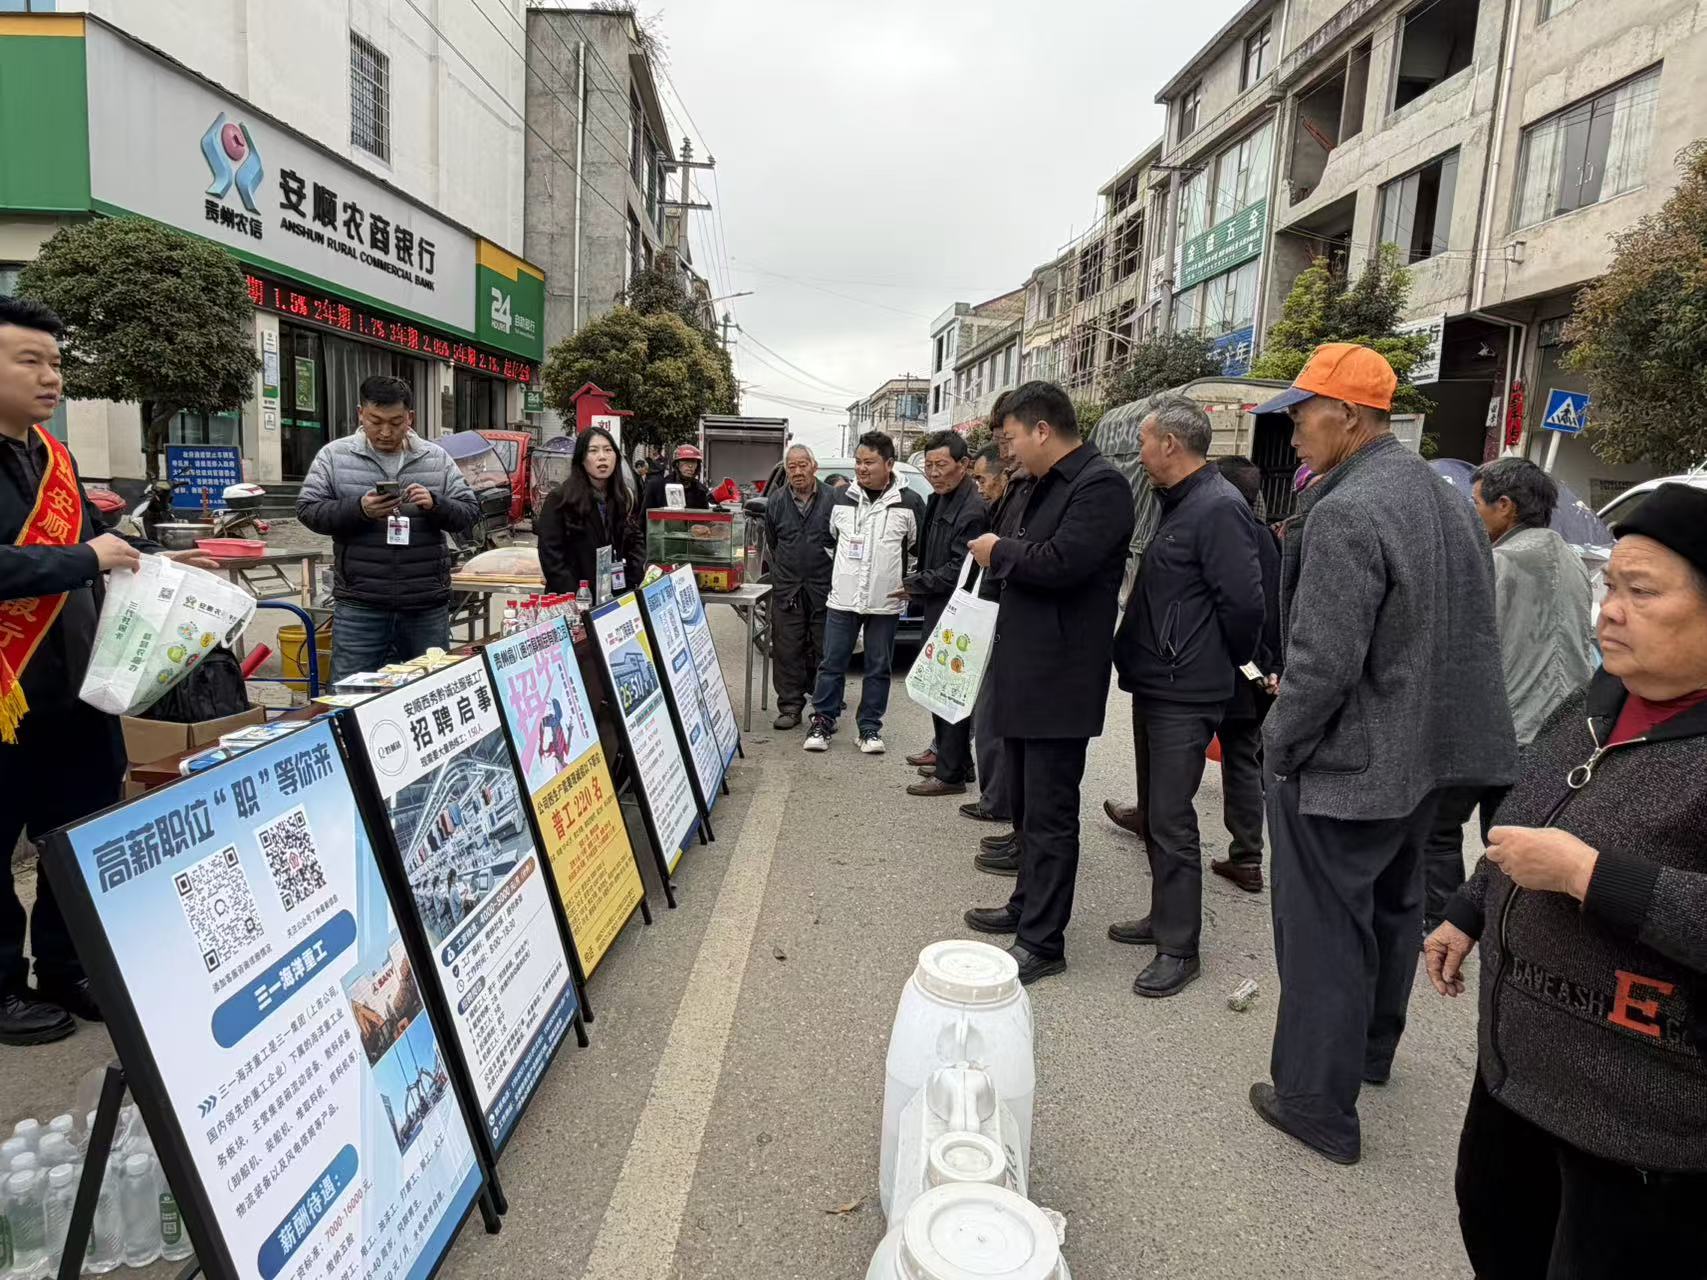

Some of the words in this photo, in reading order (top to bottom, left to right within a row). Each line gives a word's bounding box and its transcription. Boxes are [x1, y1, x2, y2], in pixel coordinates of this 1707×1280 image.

[205, 199, 263, 240] 贵州农信
[280, 168, 435, 275] 安顺农商银行
[280, 218, 325, 246] ANSHUN
[327, 237, 358, 260] RURAL
[360, 252, 413, 283] COMMERCIAL
[415, 275, 435, 292] BANK
[274, 288, 308, 316] 1.5%
[314, 299, 352, 330] 2年期
[358, 314, 387, 338] 1.7%
[389, 322, 419, 350] 3年期
[453, 344, 477, 365] 5年期
[491, 287, 512, 334] 24
[410, 685, 491, 752] 招聘启事
[551, 801, 576, 840] 普工
[574, 786, 593, 818] 220
[254, 939, 328, 1011] 三一海洋重工
[378, 968, 395, 990] SANY
